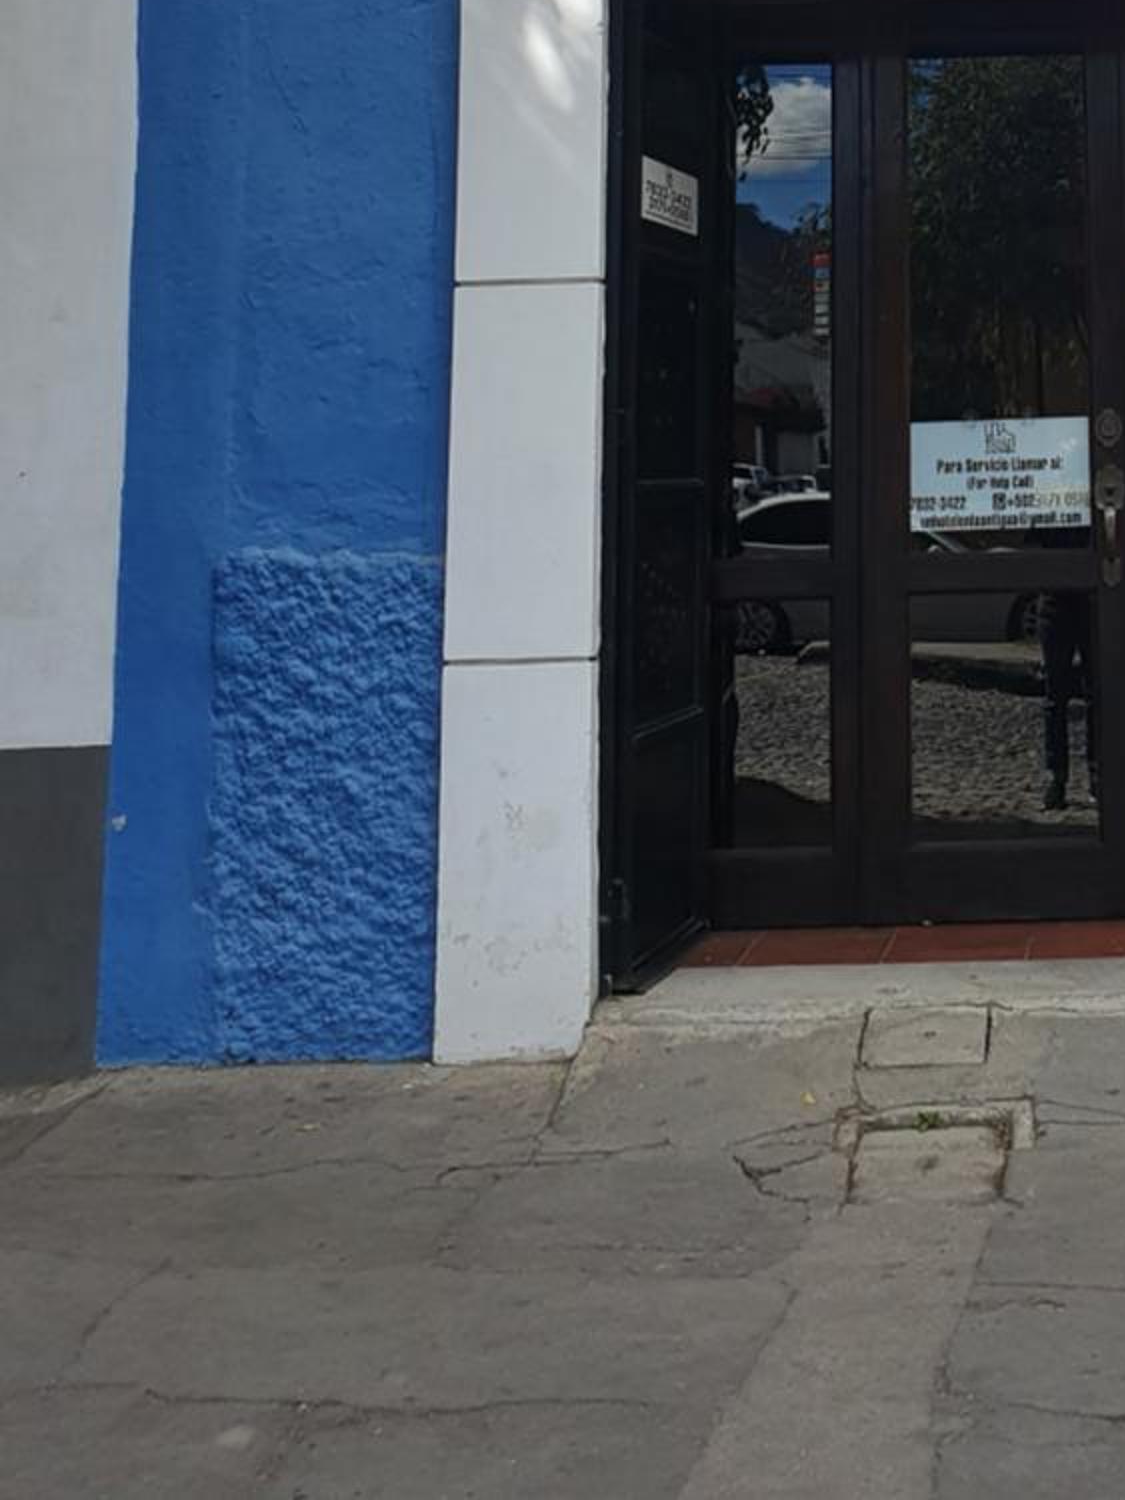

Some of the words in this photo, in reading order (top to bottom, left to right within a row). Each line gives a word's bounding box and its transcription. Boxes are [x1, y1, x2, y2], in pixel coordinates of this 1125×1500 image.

[936, 459, 963, 475] Para
[966, 457, 1009, 473] Servicio
[1011, 456, 1048, 471] Llamar
